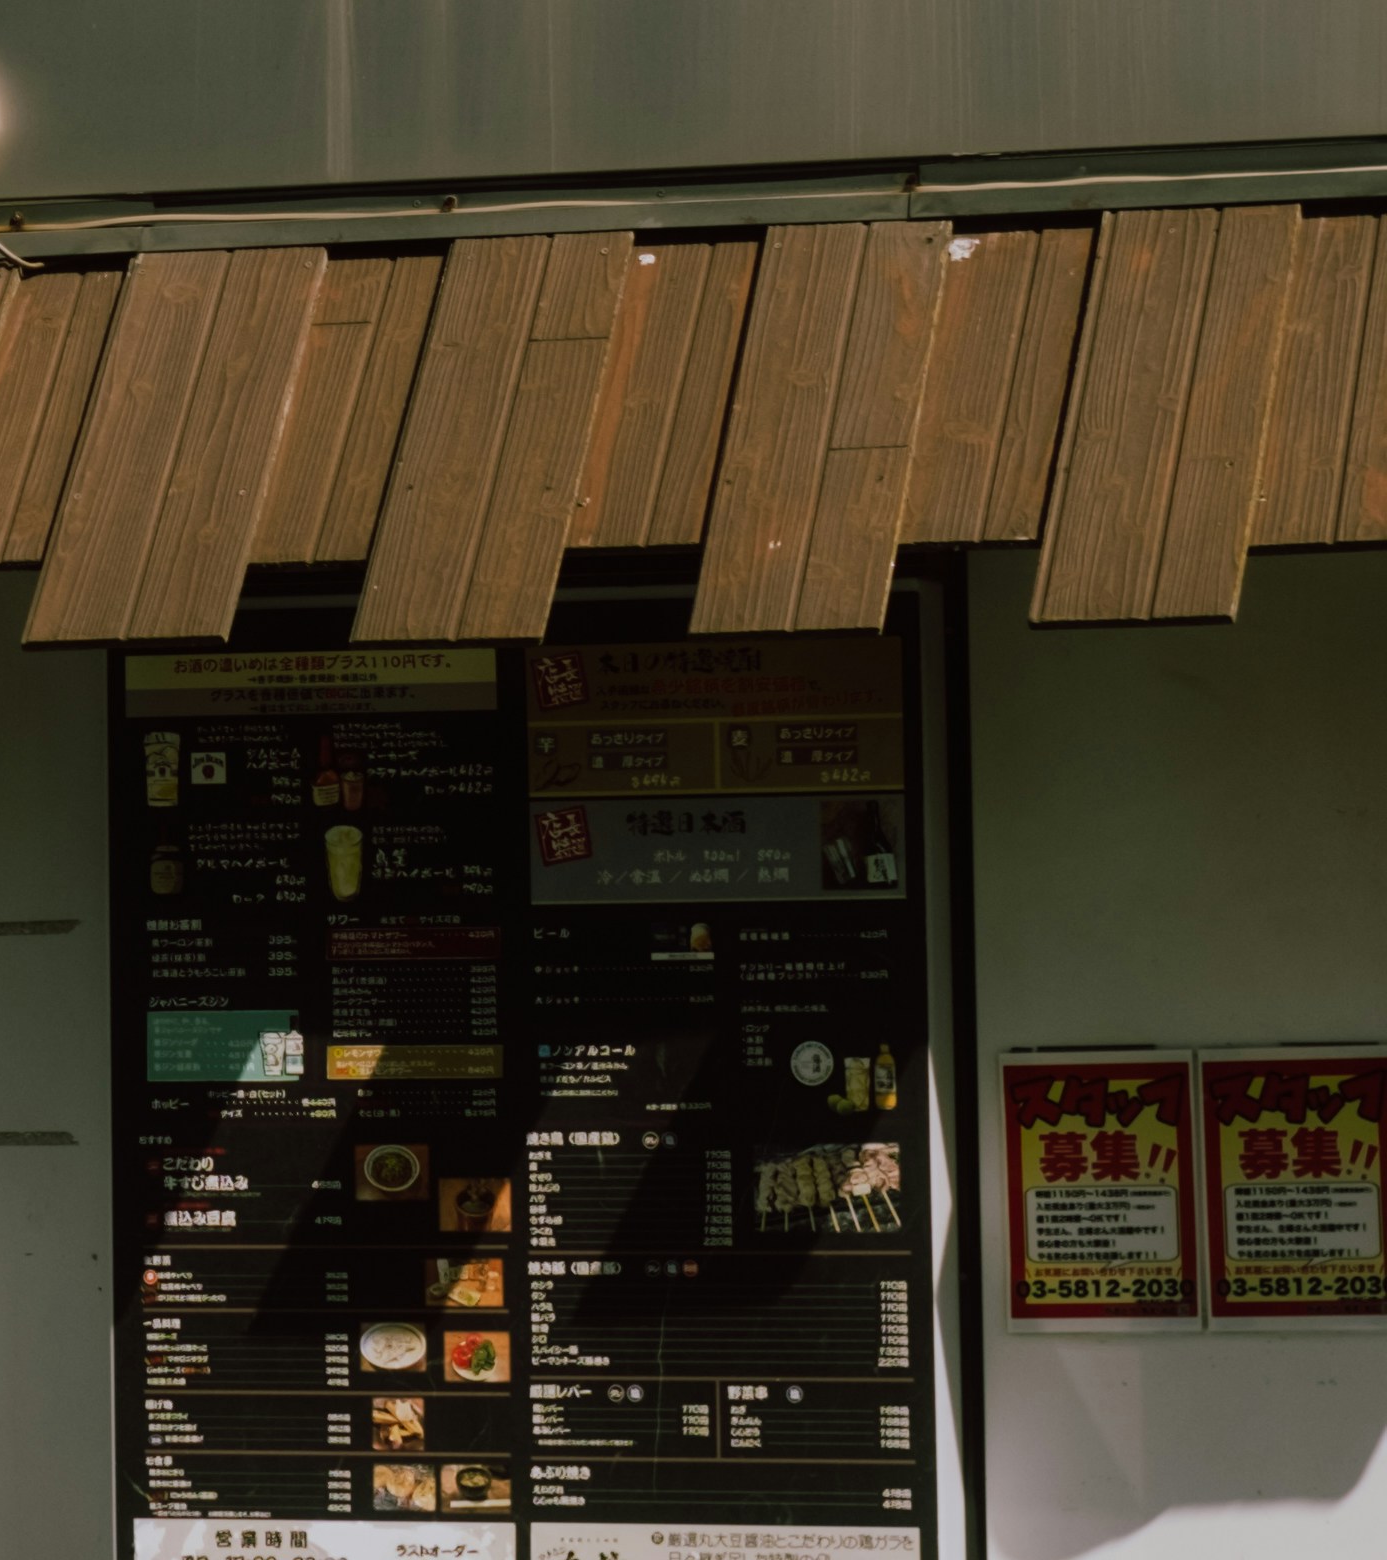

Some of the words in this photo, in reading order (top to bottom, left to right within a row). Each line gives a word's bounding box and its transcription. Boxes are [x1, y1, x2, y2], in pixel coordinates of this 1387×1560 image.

[1011, 1073, 1184, 1129] スタッフ
[1211, 1070, 1386, 1126] スタッフ
[163, 1156, 215, 1173] こだわり
[1016, 1278, 1195, 1298] 03-5812-2030
[1217, 1276, 1387, 1297] 03-5812-203
[215, 1529, 309, 1549] 営業時間
[395, 1544, 479, 1558] ラストオーダー
